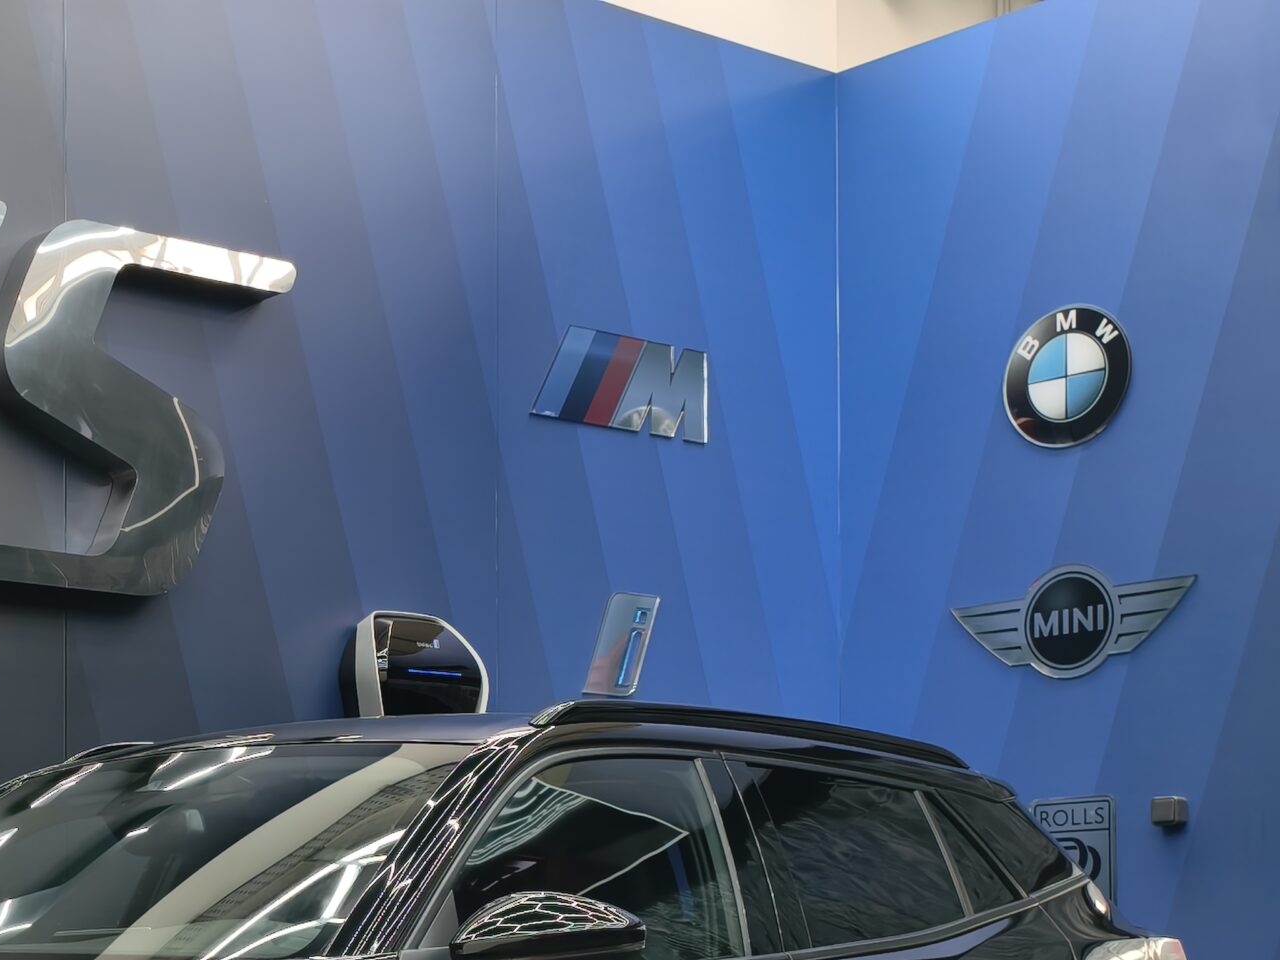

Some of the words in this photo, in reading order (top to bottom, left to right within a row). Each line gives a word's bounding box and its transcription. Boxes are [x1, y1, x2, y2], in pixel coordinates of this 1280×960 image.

[1016, 309, 1119, 361] BMW
[1033, 604, 1105, 639] MINI
[1040, 806, 1105, 828] ROLLS
